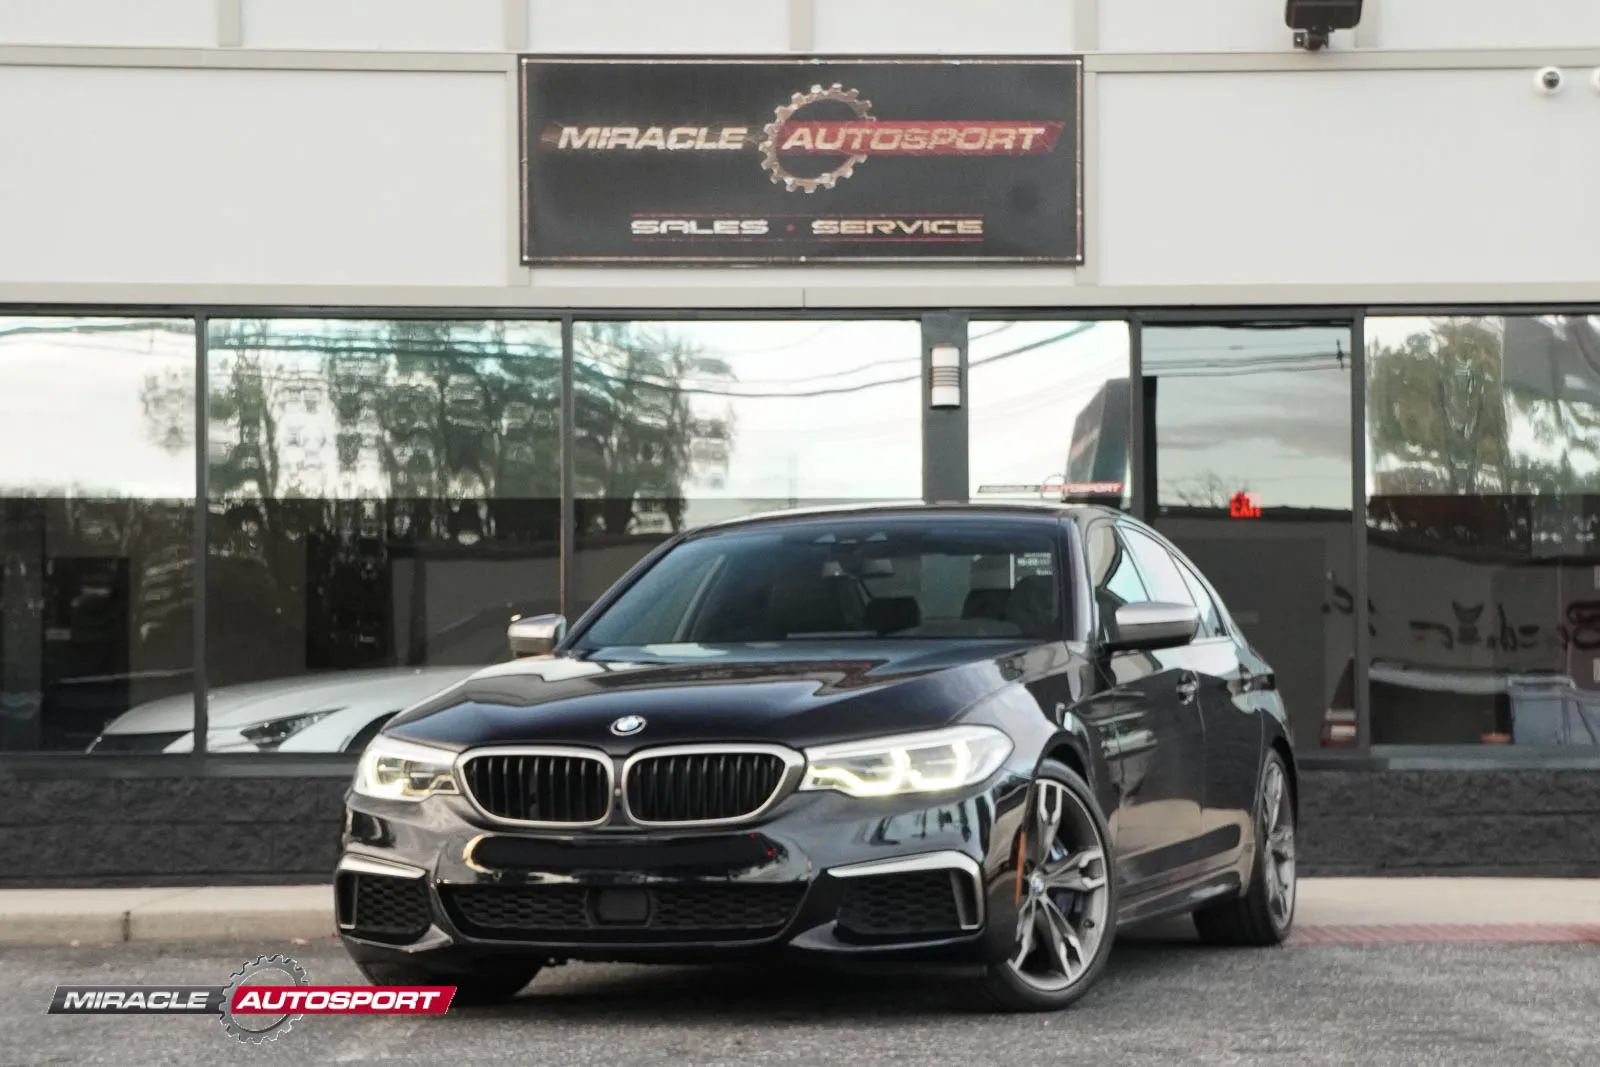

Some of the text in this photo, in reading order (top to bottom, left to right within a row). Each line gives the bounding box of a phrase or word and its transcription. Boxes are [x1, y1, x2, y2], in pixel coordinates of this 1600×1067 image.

[557, 126, 1046, 151] MIRACLE AUTOSPORT
[631, 219, 984, 236] SALES SERVICE
